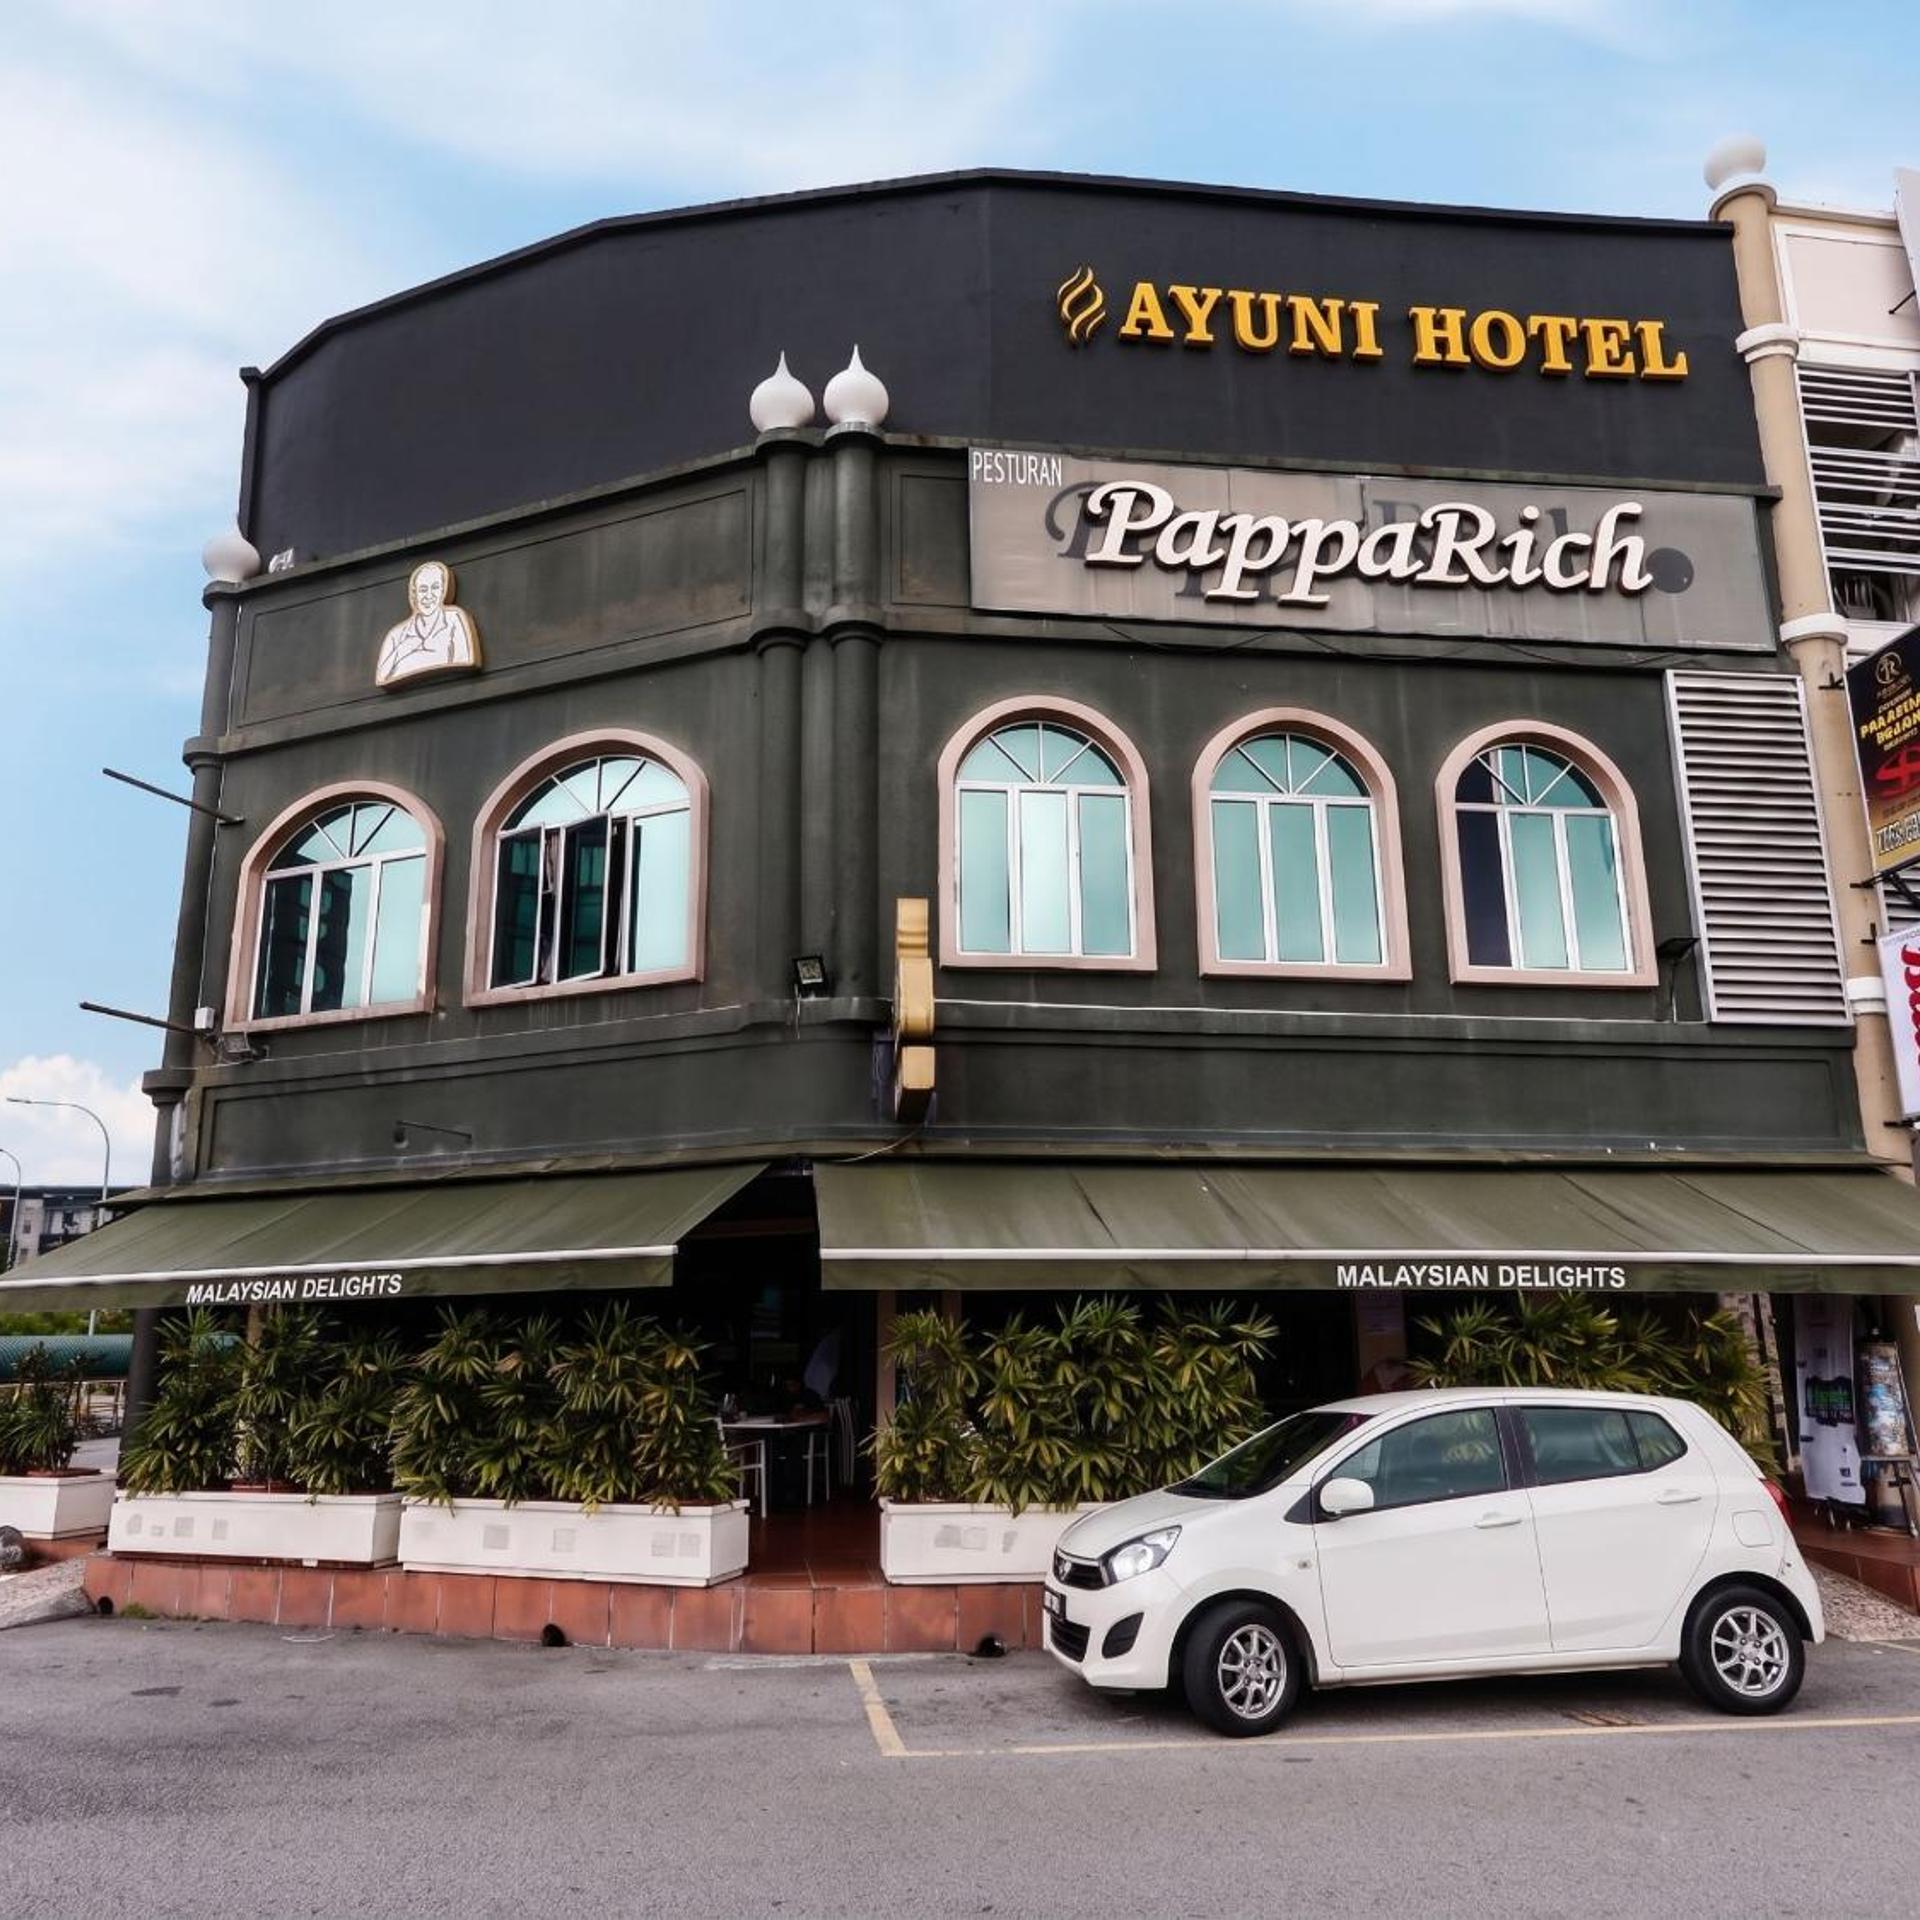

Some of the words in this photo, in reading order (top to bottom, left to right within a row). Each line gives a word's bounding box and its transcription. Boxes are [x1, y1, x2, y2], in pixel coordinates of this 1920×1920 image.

[1119, 282, 1384, 358] AYUNI
[1409, 305, 1689, 381] HOTEL
[1085, 480, 1653, 606] PappaRich
[185, 1279, 297, 1304] MALAYSIAN
[302, 1273, 403, 1299] DELIGHTS
[1336, 1264, 1489, 1288] MALAYSIAN
[1498, 1265, 1626, 1289] DELIGHTS
